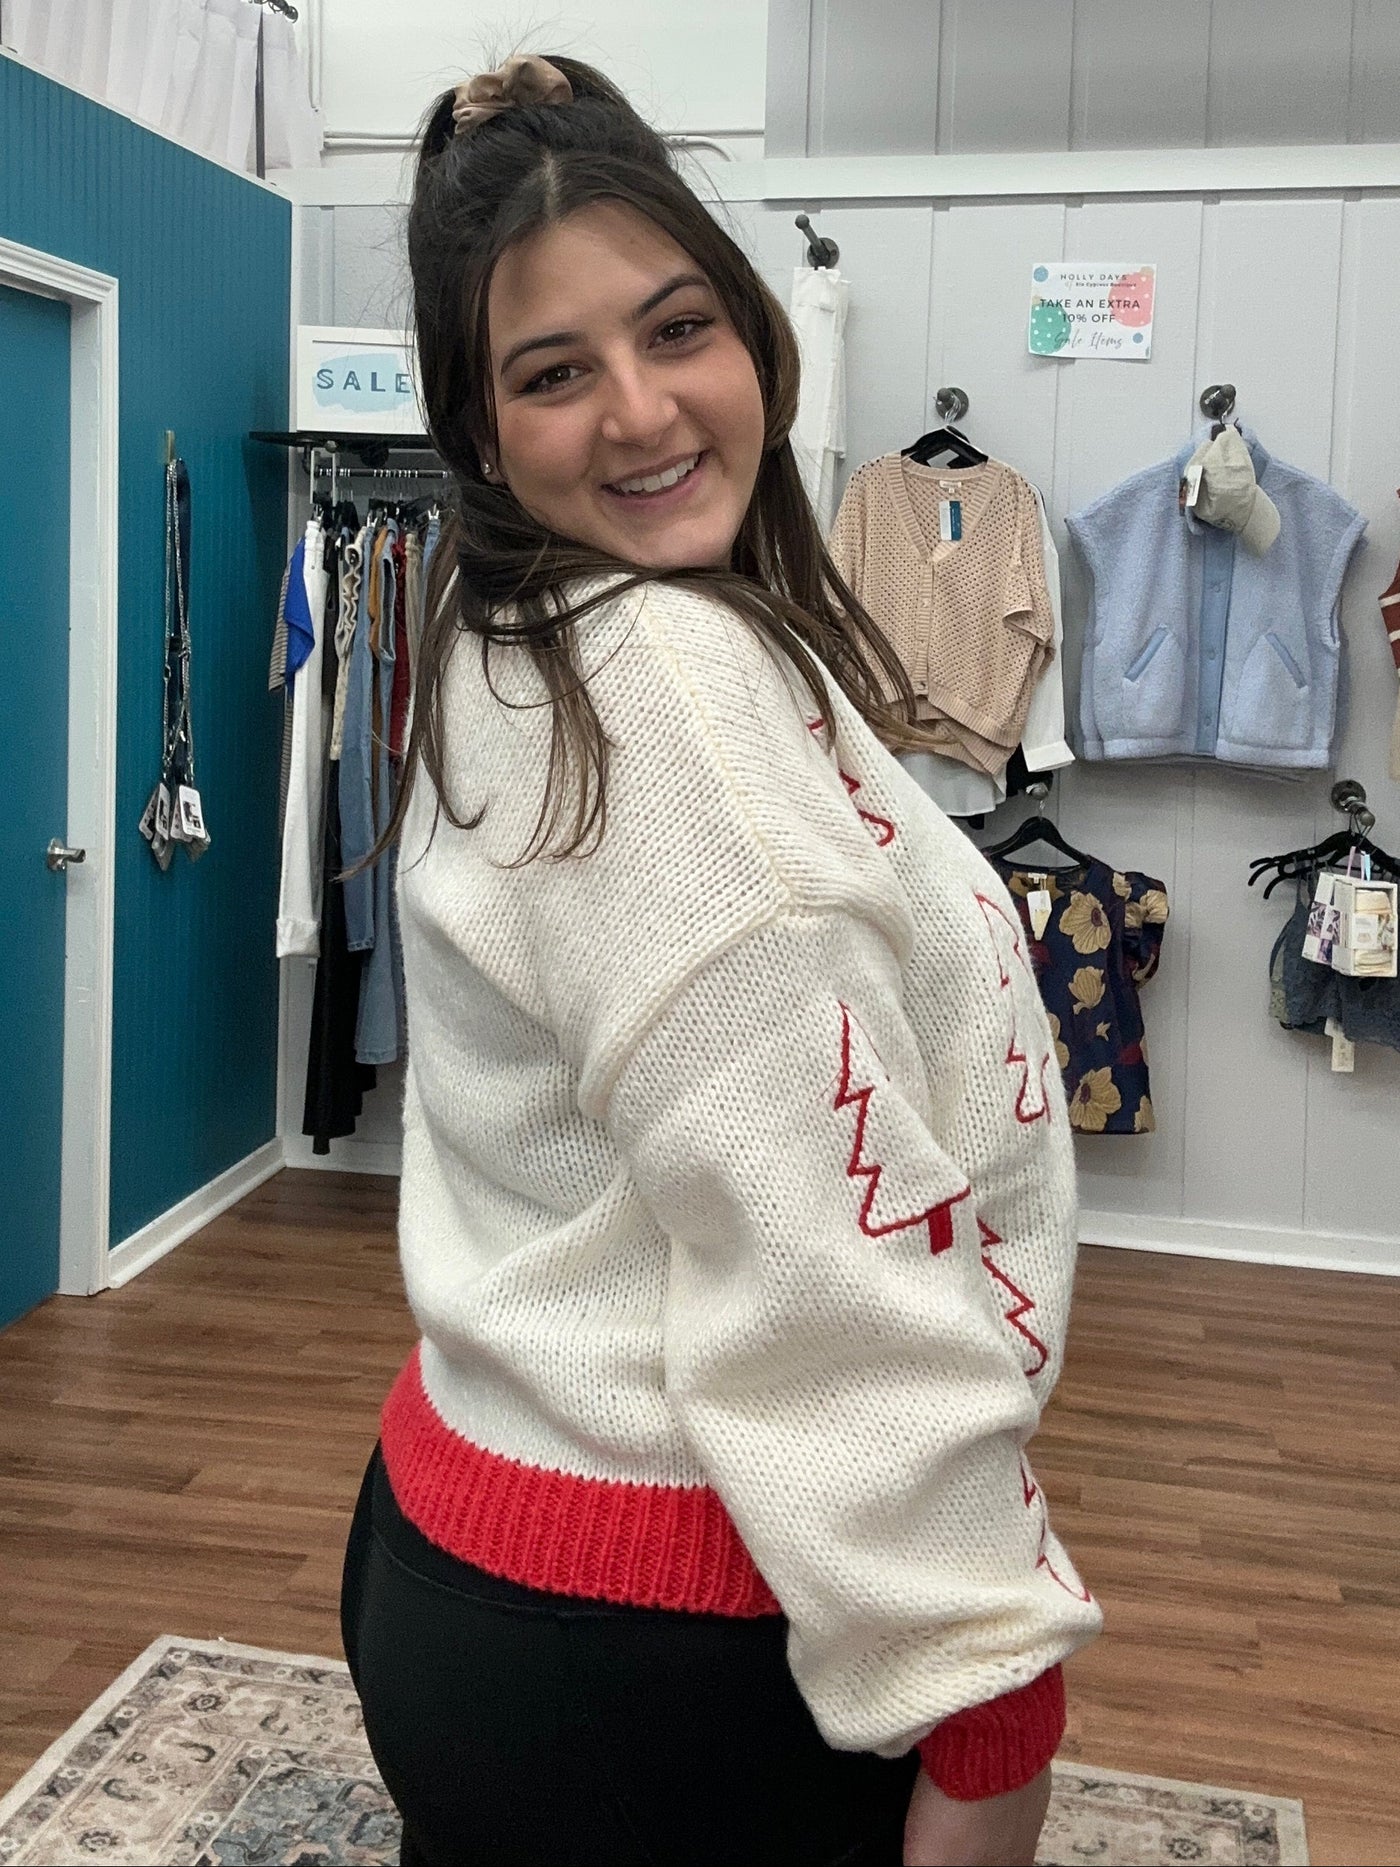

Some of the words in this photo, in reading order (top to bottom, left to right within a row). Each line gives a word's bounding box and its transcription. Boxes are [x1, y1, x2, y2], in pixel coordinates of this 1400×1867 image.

[1040, 299, 1072, 308] TAKE
[1076, 300, 1094, 309] AN
[1099, 299, 1140, 309] EXTRA
[1063, 313, 1087, 323] 10%
[1091, 314, 1116, 323] OFF
[1054, 329, 1083, 349] Sale
[1089, 331, 1122, 350] Items
[316, 368, 411, 394] SALE
